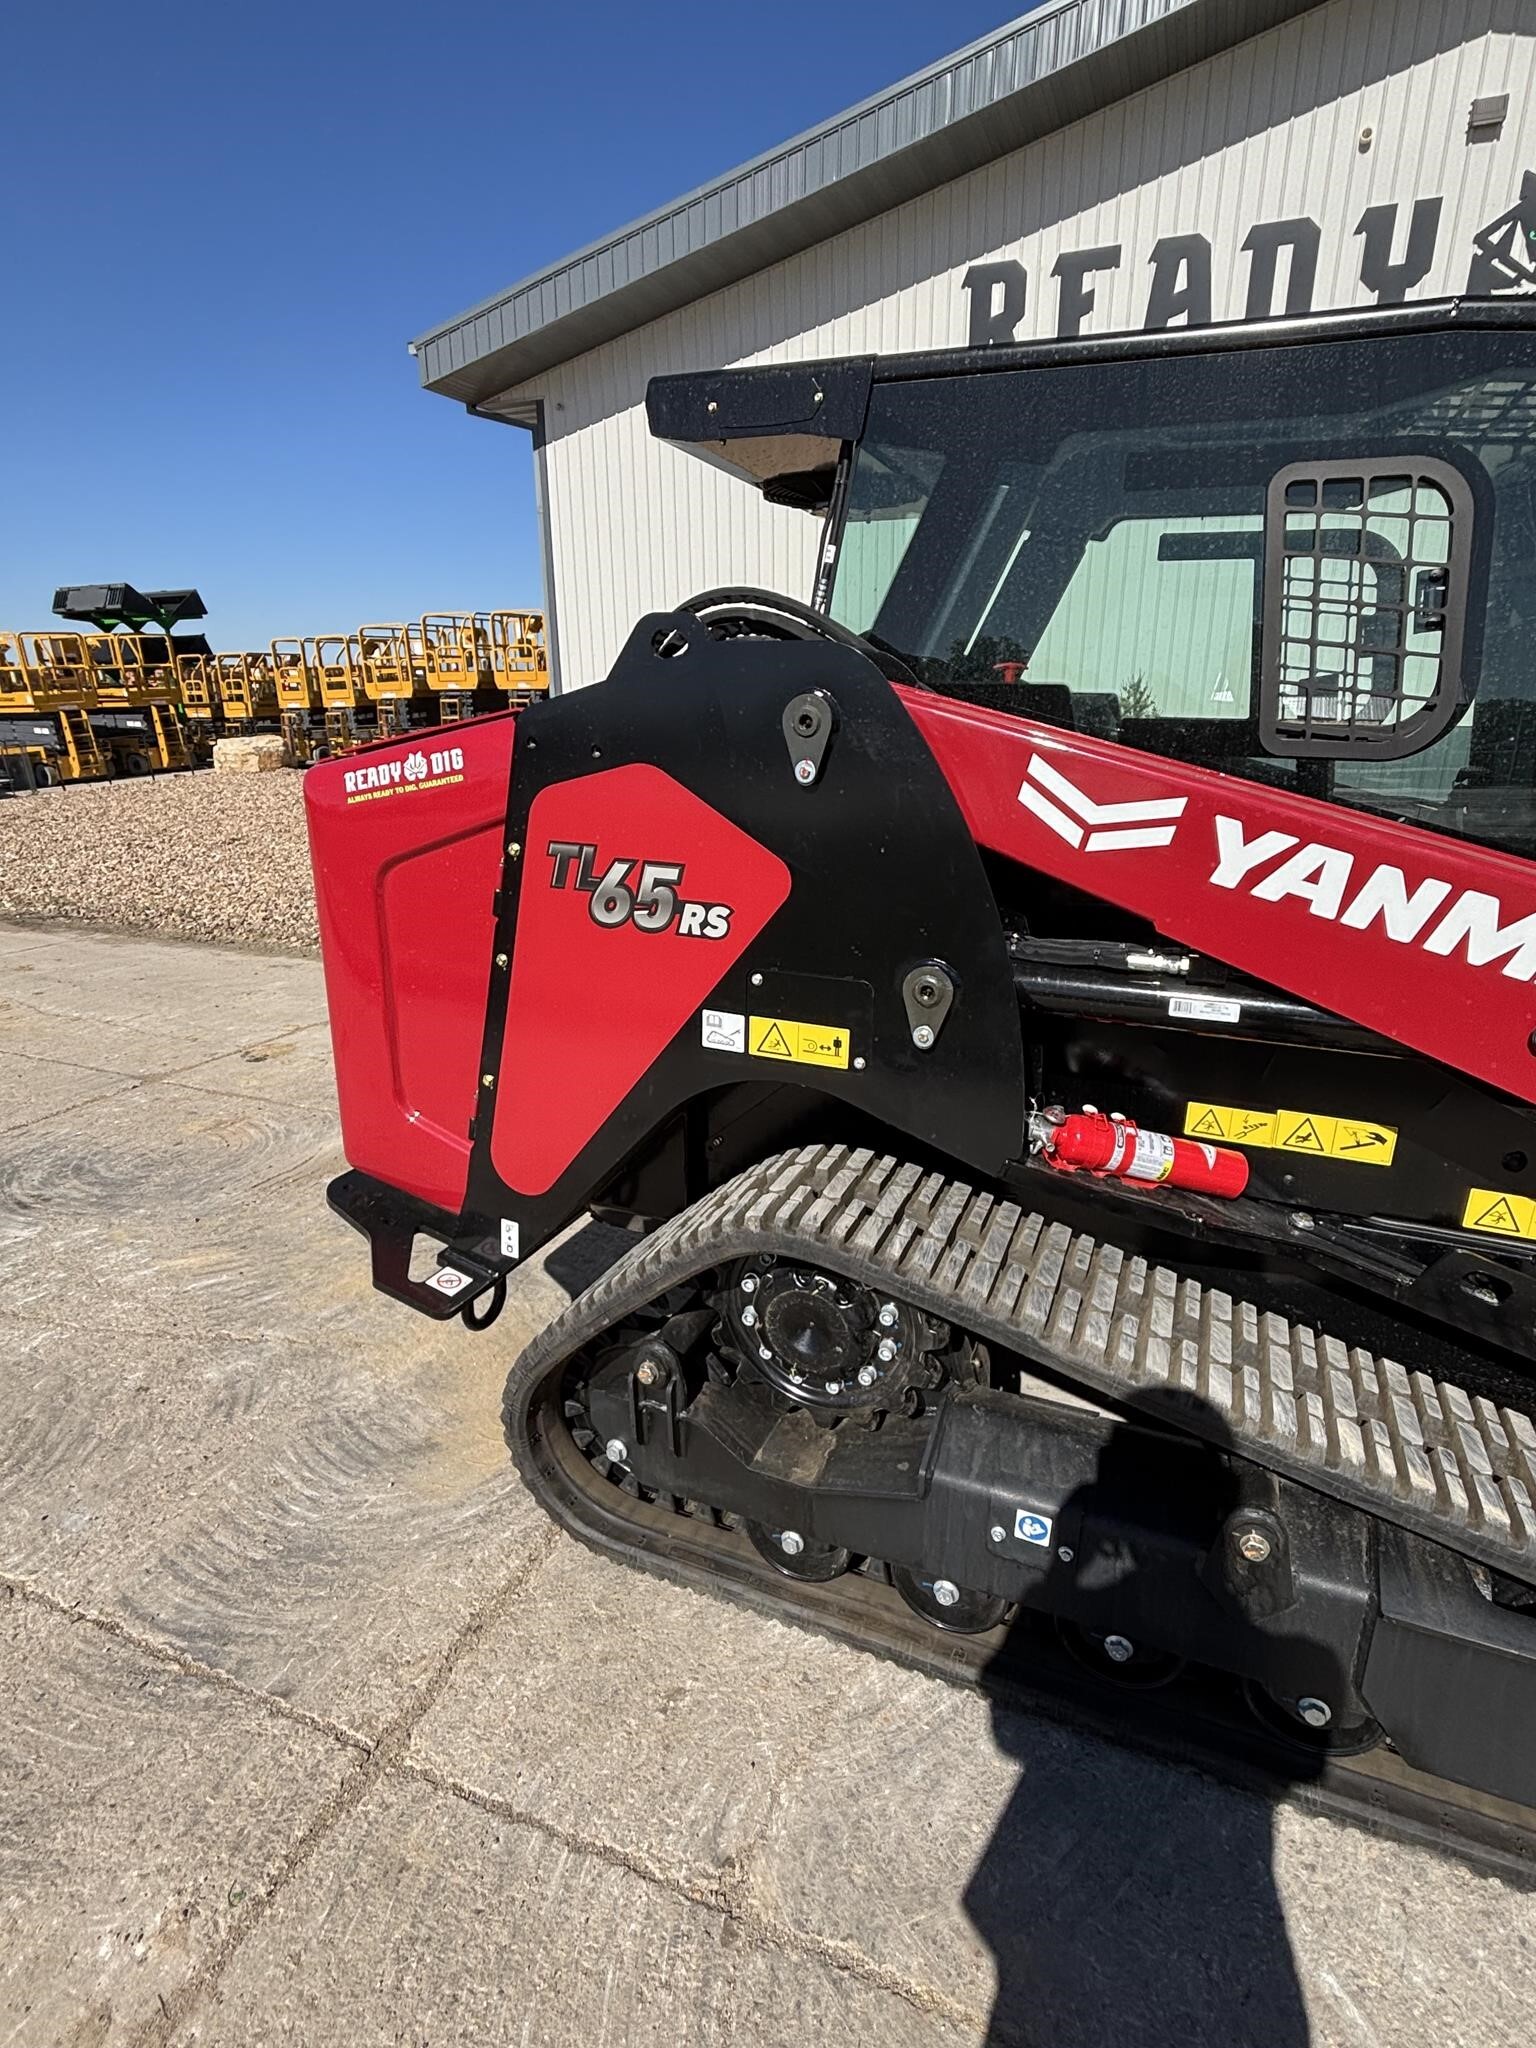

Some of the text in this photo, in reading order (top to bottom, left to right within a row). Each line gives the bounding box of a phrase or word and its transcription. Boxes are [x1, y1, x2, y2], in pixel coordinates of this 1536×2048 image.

[961, 196, 1444, 347] READY
[343, 747, 464, 793] READY DIG
[347, 792, 373, 804] ALWAYS
[373, 788, 394, 799] READY
[395, 786, 404, 795] TO
[418, 774, 464, 790] GUARANTEED
